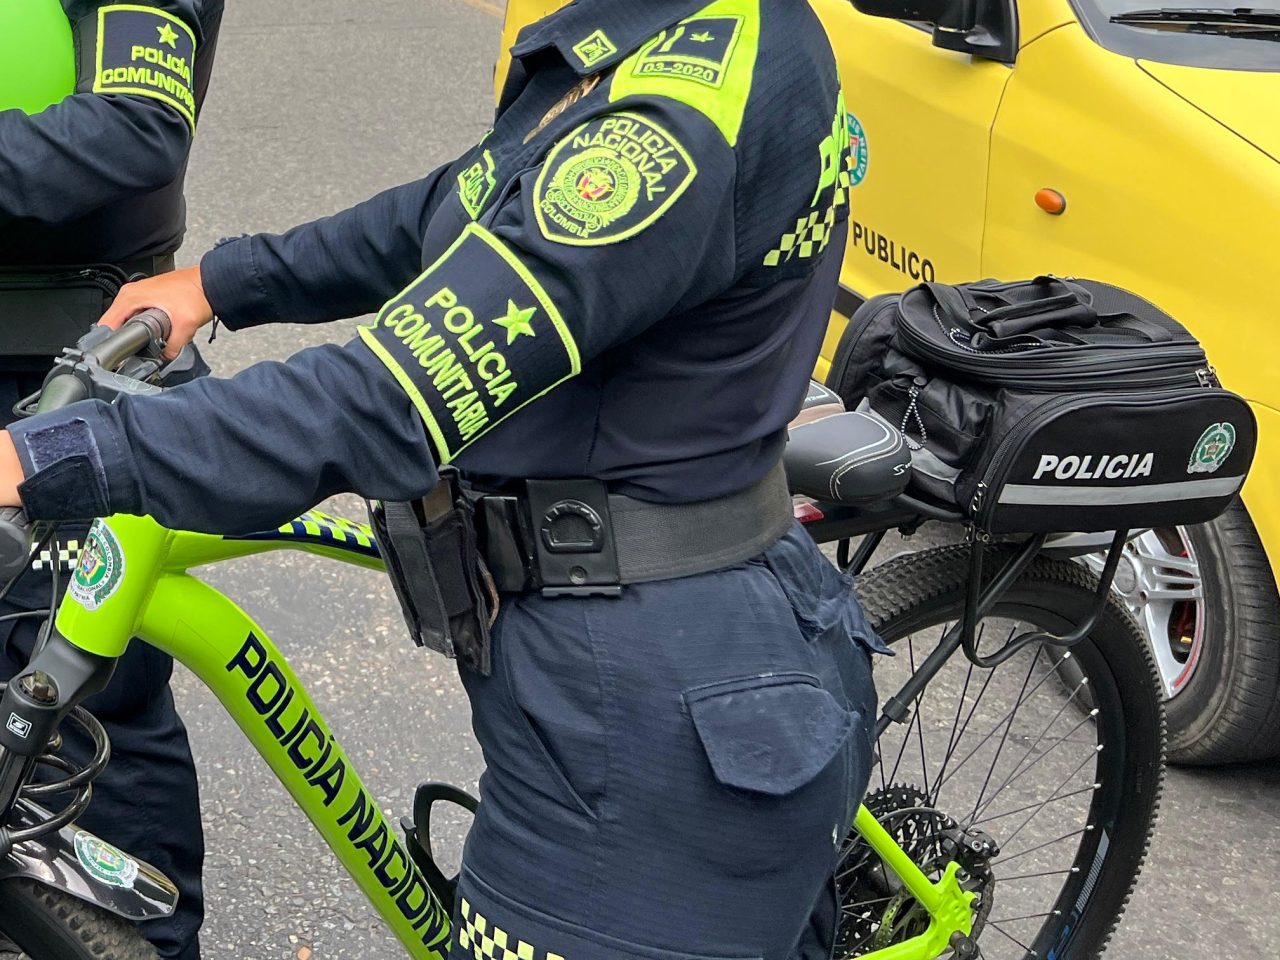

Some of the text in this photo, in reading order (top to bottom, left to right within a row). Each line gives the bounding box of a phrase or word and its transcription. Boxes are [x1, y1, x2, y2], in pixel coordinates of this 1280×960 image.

[643, 62, 715, 82] 03-2020
[572, 132, 666, 202] NACIONAL
[539, 198, 590, 238] COLOMBIA
[852, 220, 935, 283] PUBLICO
[384, 304, 490, 441] COMUNITARIA
[424, 287, 518, 408] POLICIA
[1032, 453, 1155, 480] POLICIA
